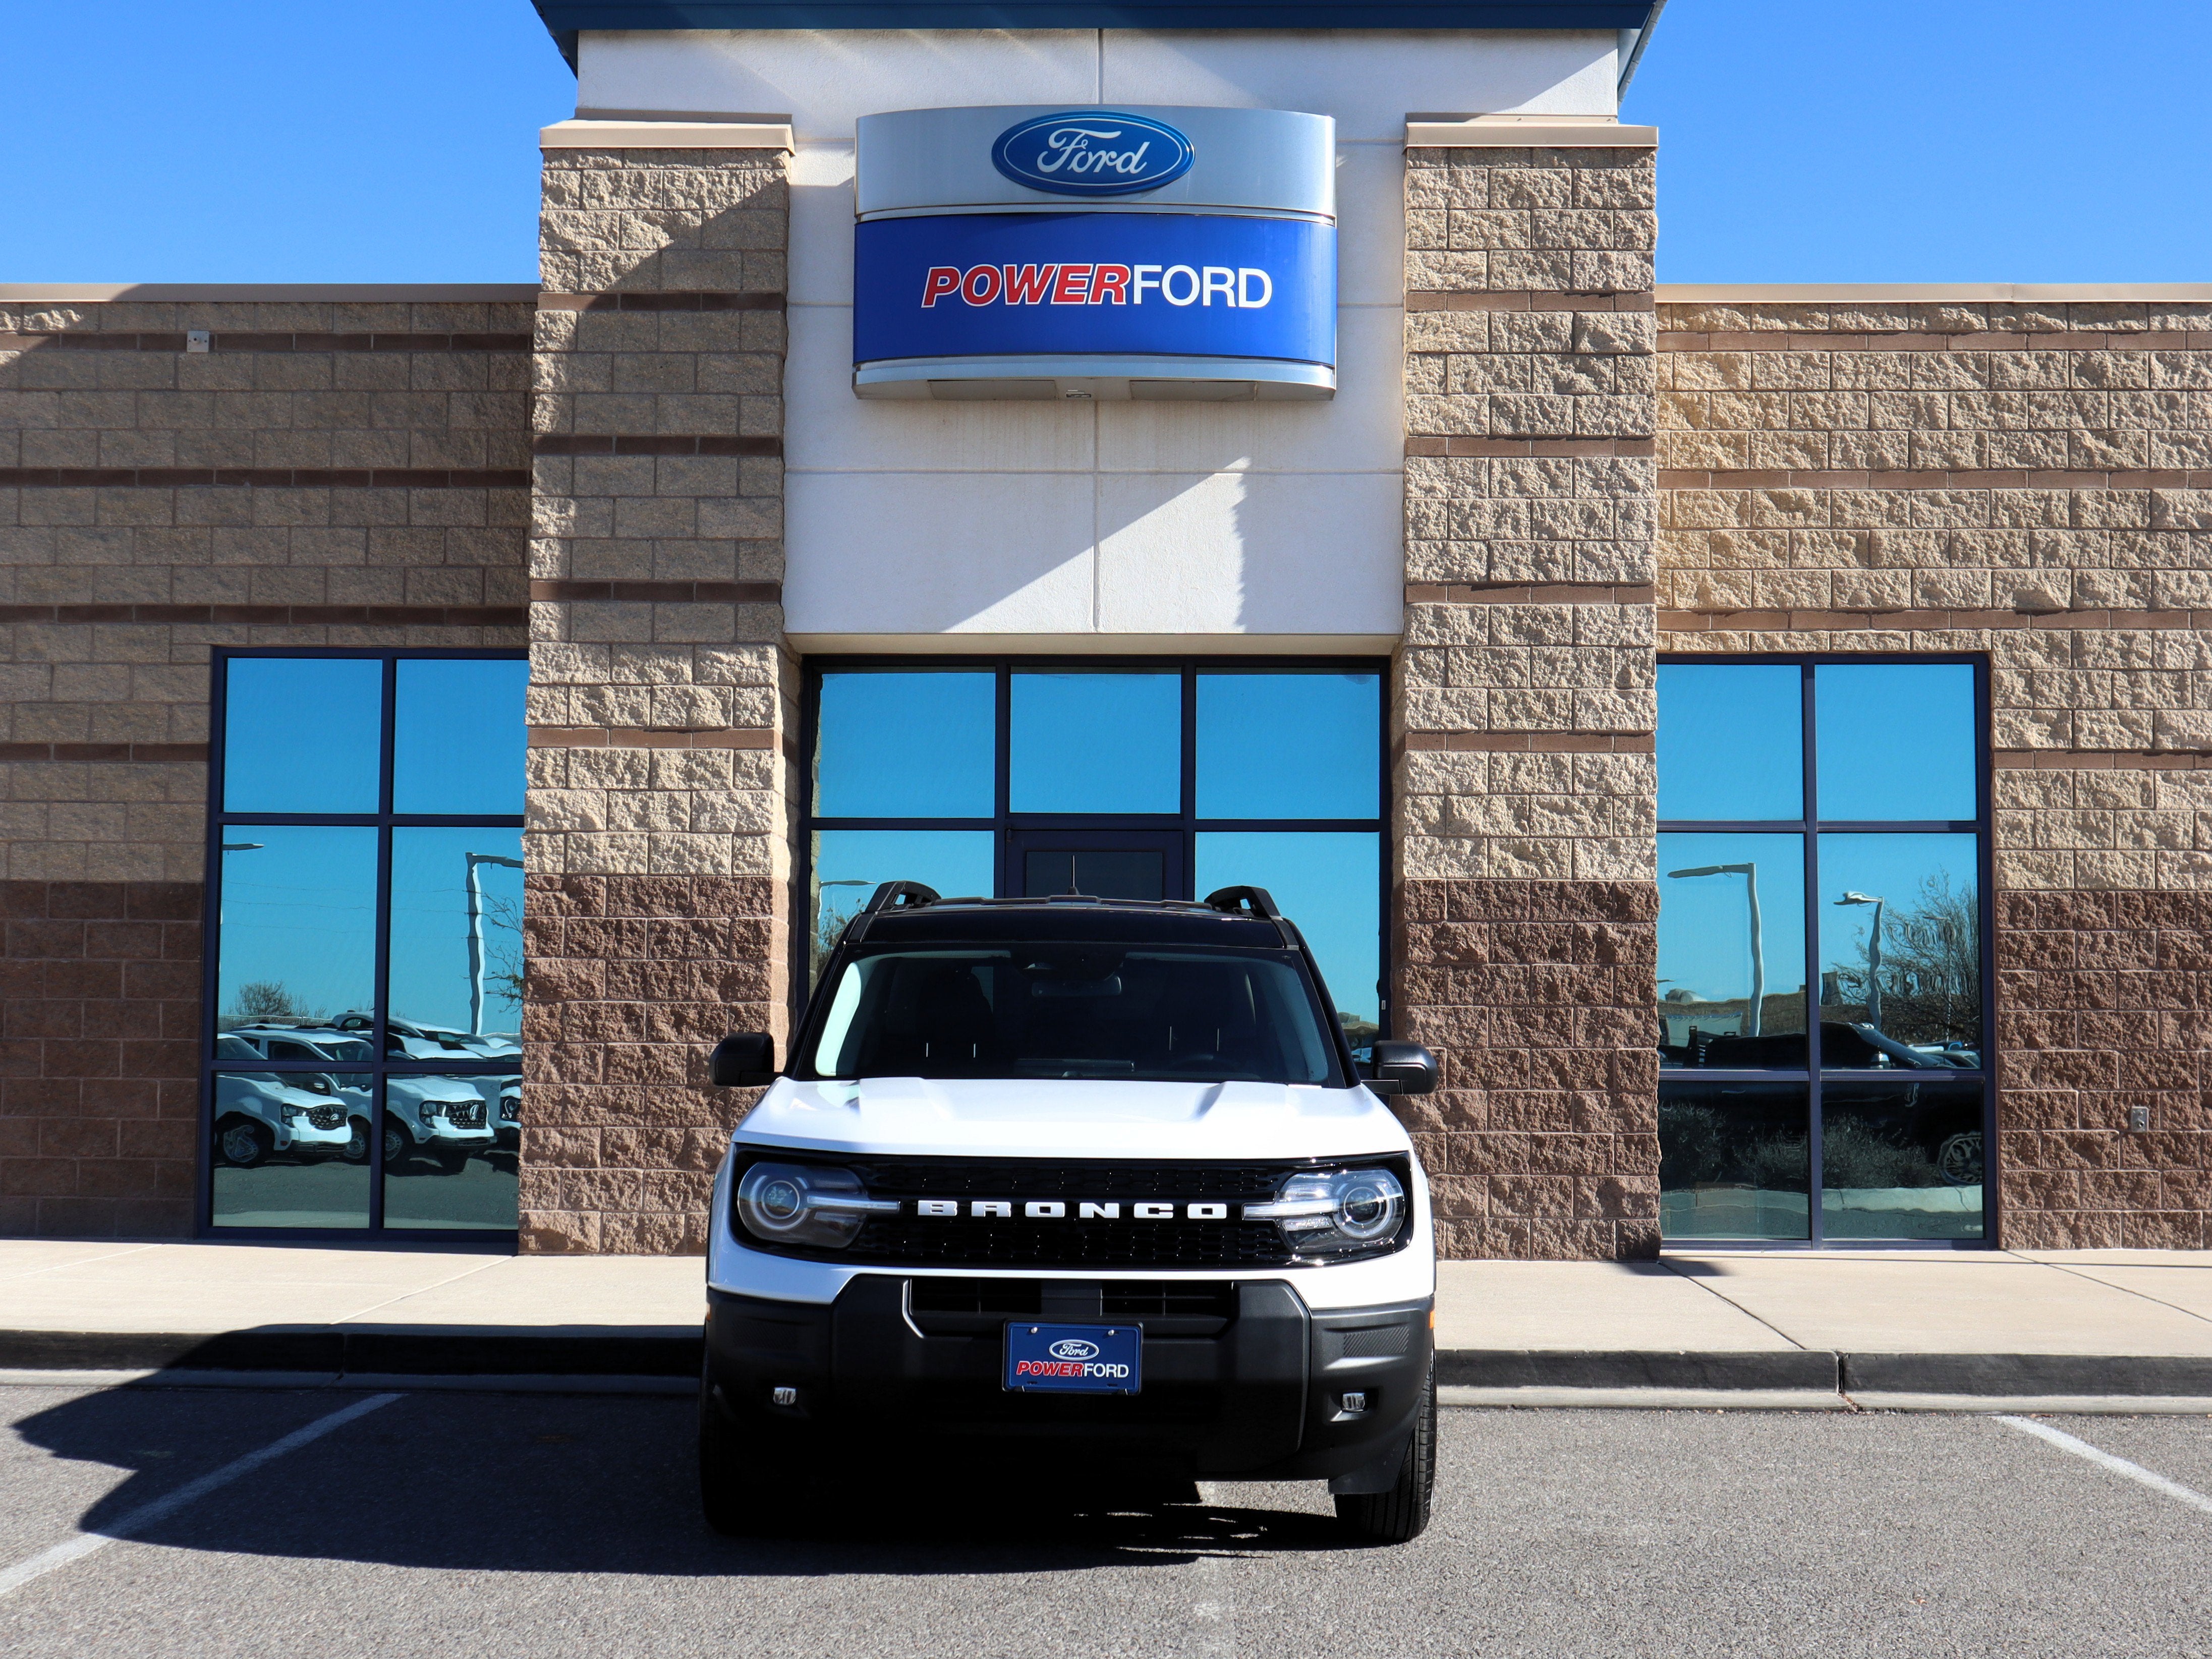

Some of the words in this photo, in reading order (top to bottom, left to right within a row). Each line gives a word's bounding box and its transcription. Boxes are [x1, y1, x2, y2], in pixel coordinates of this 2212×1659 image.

[1037, 128, 1150, 174] Ford
[921, 263, 1273, 309] POWERFORD
[918, 1200, 1227, 1219] BRONCO
[1059, 1342, 1089, 1356] Ford
[1015, 1361, 1129, 1378] POWERFORD
